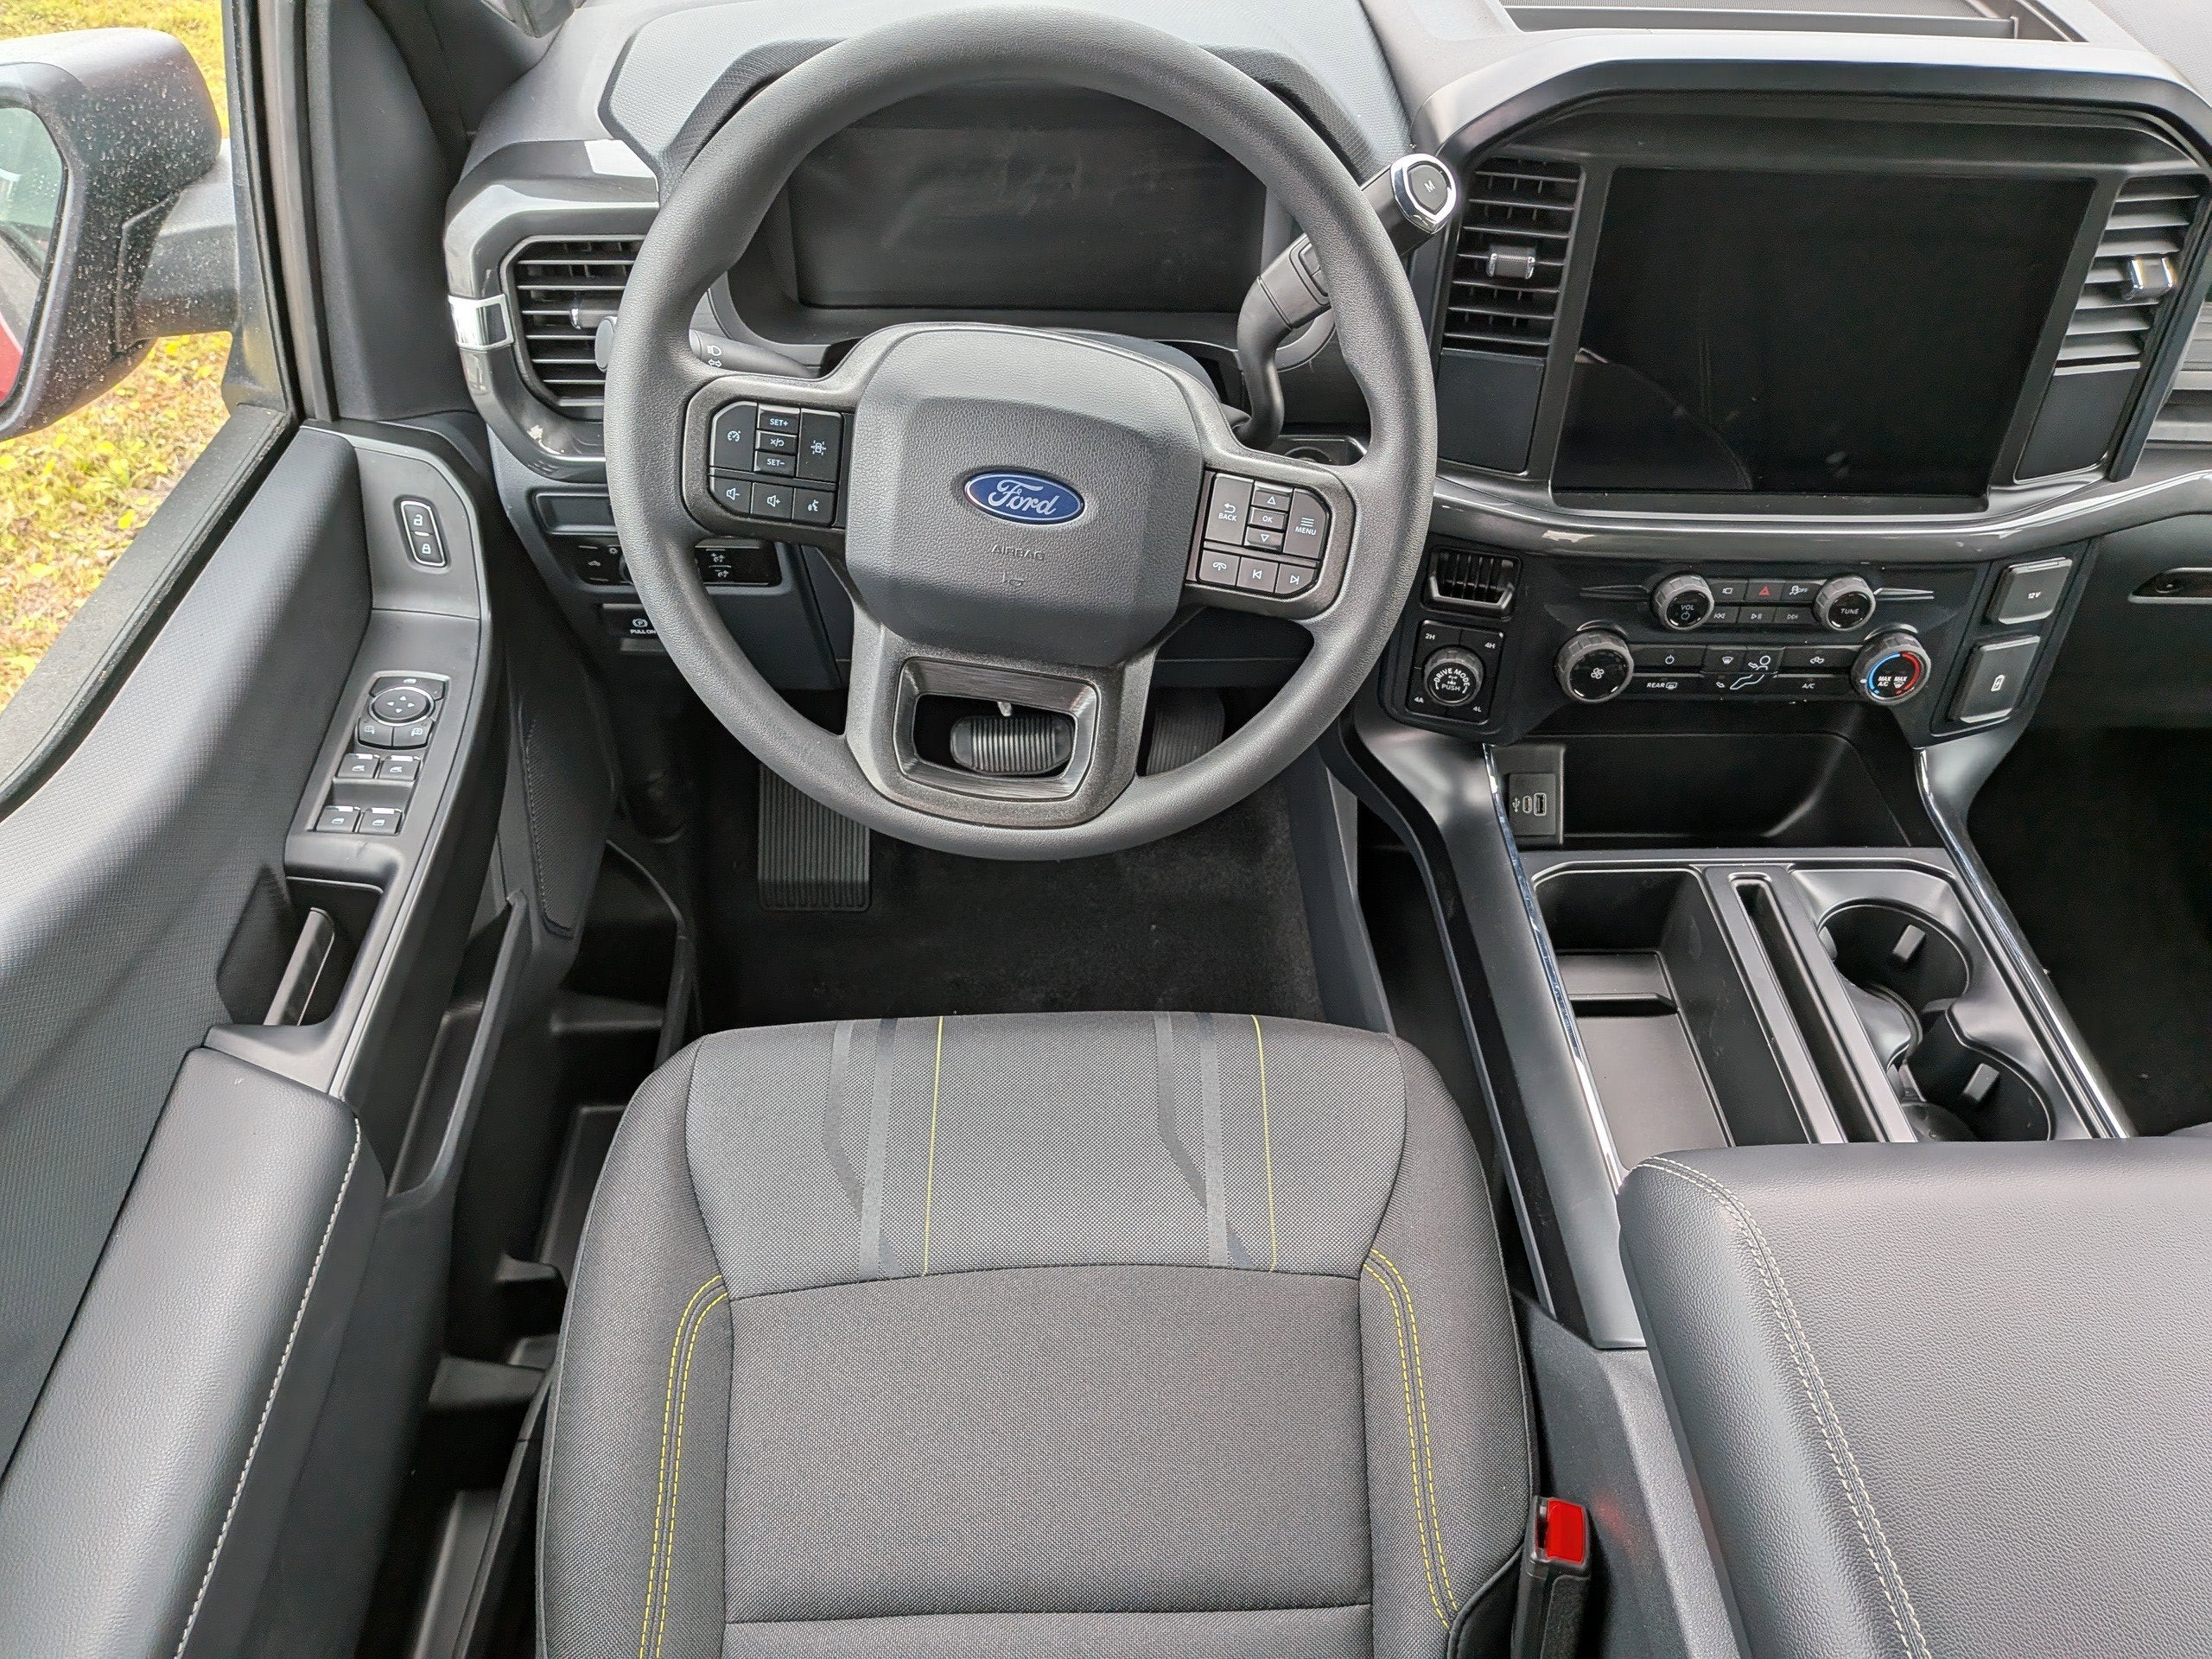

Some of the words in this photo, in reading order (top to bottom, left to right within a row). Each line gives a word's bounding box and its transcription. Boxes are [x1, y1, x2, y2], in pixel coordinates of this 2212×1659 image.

[1424, 180, 1435, 193] M
[769, 417, 789, 427] SET+
[988, 479, 1060, 516] Ford
[1218, 512, 1237, 523] BACK
[1262, 515, 1274, 524] OK
[1294, 526, 1317, 537] MENU
[991, 545, 1045, 562] AIRBAG
[1433, 667, 1452, 683] DRIVE
[1453, 668, 1471, 687] MODE
